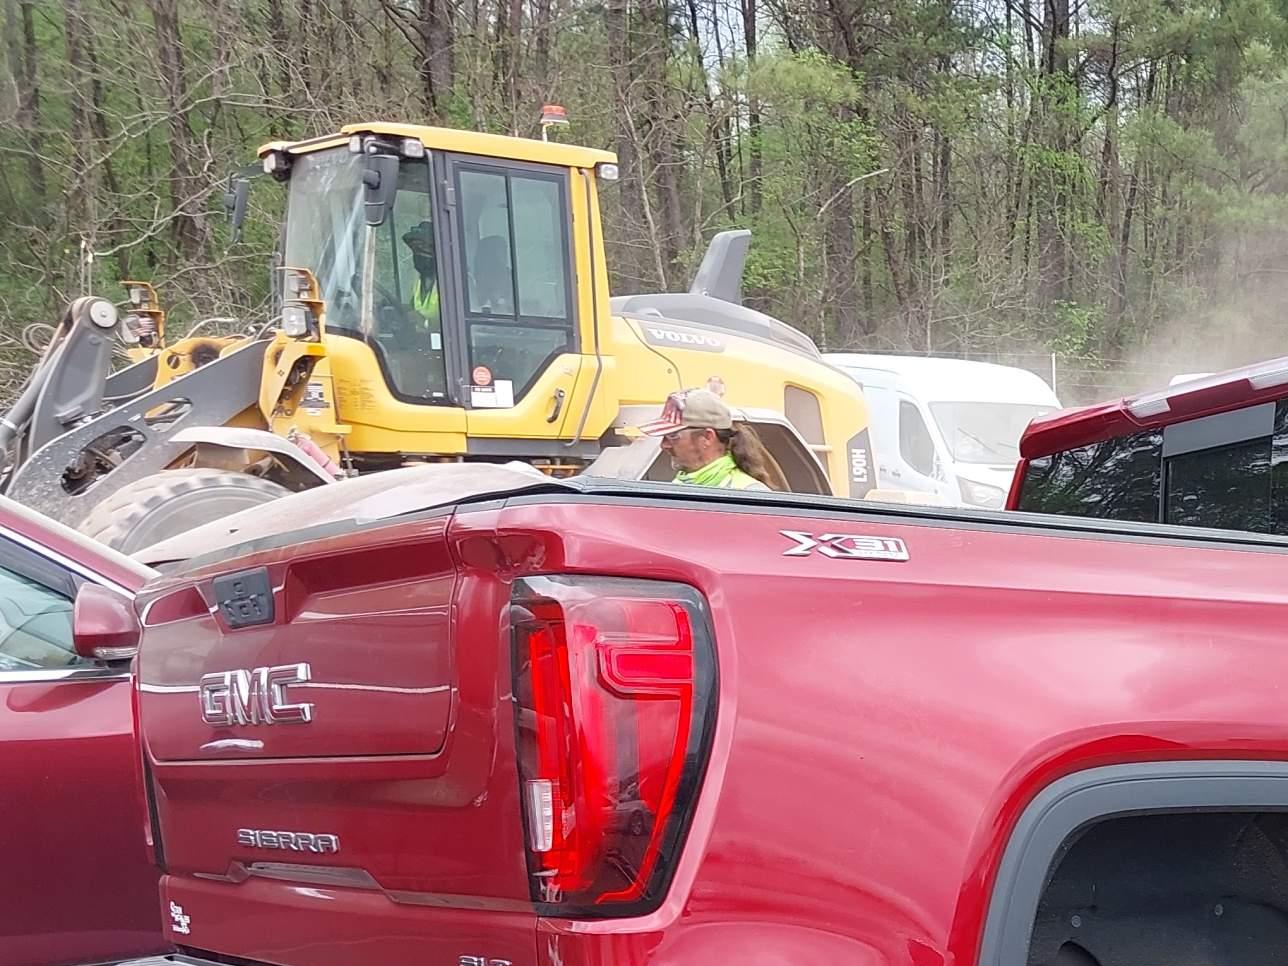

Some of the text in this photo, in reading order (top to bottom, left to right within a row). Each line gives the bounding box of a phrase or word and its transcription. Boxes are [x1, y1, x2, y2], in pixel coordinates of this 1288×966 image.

[647, 328, 722, 347] VOLVO
[851, 448, 868, 483] L90H
[199, 662, 314, 726] GMC
[236, 828, 340, 853] SIERRA
